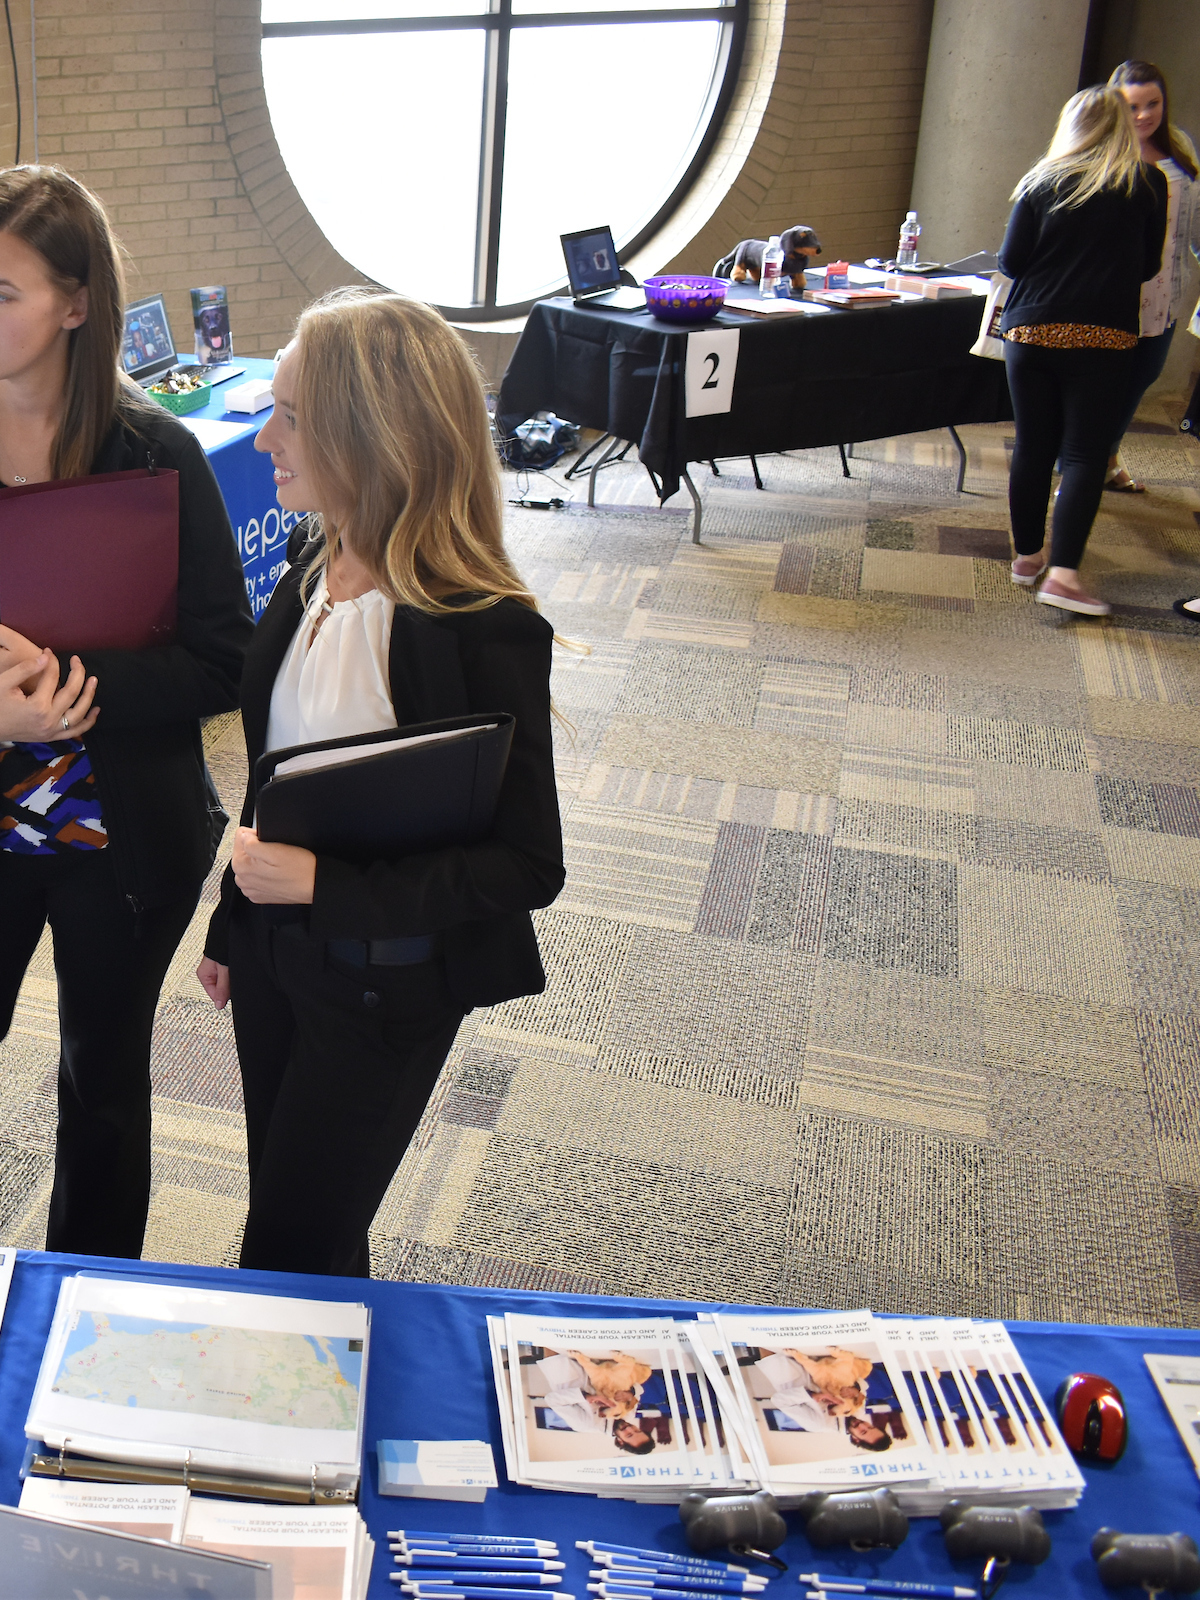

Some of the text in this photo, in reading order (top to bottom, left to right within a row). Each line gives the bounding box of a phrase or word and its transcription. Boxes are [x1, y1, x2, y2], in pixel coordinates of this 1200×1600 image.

[701, 352, 720, 390] 2
[609, 1466, 683, 1478] THRIVE
[848, 1461, 927, 1477] THRIVE
[64, 1501, 110, 1509] POTENTIAL
[837, 1502, 871, 1510] THRIVE
[977, 1515, 1013, 1523] THRIVE
[480, 1545, 520, 1553] THRIVE
[668, 1554, 708, 1566] THRIVE
[687, 1566, 727, 1578] THRIVE
[684, 1576, 724, 1585] THRIVE
[894, 1582, 936, 1591] THRIVE
